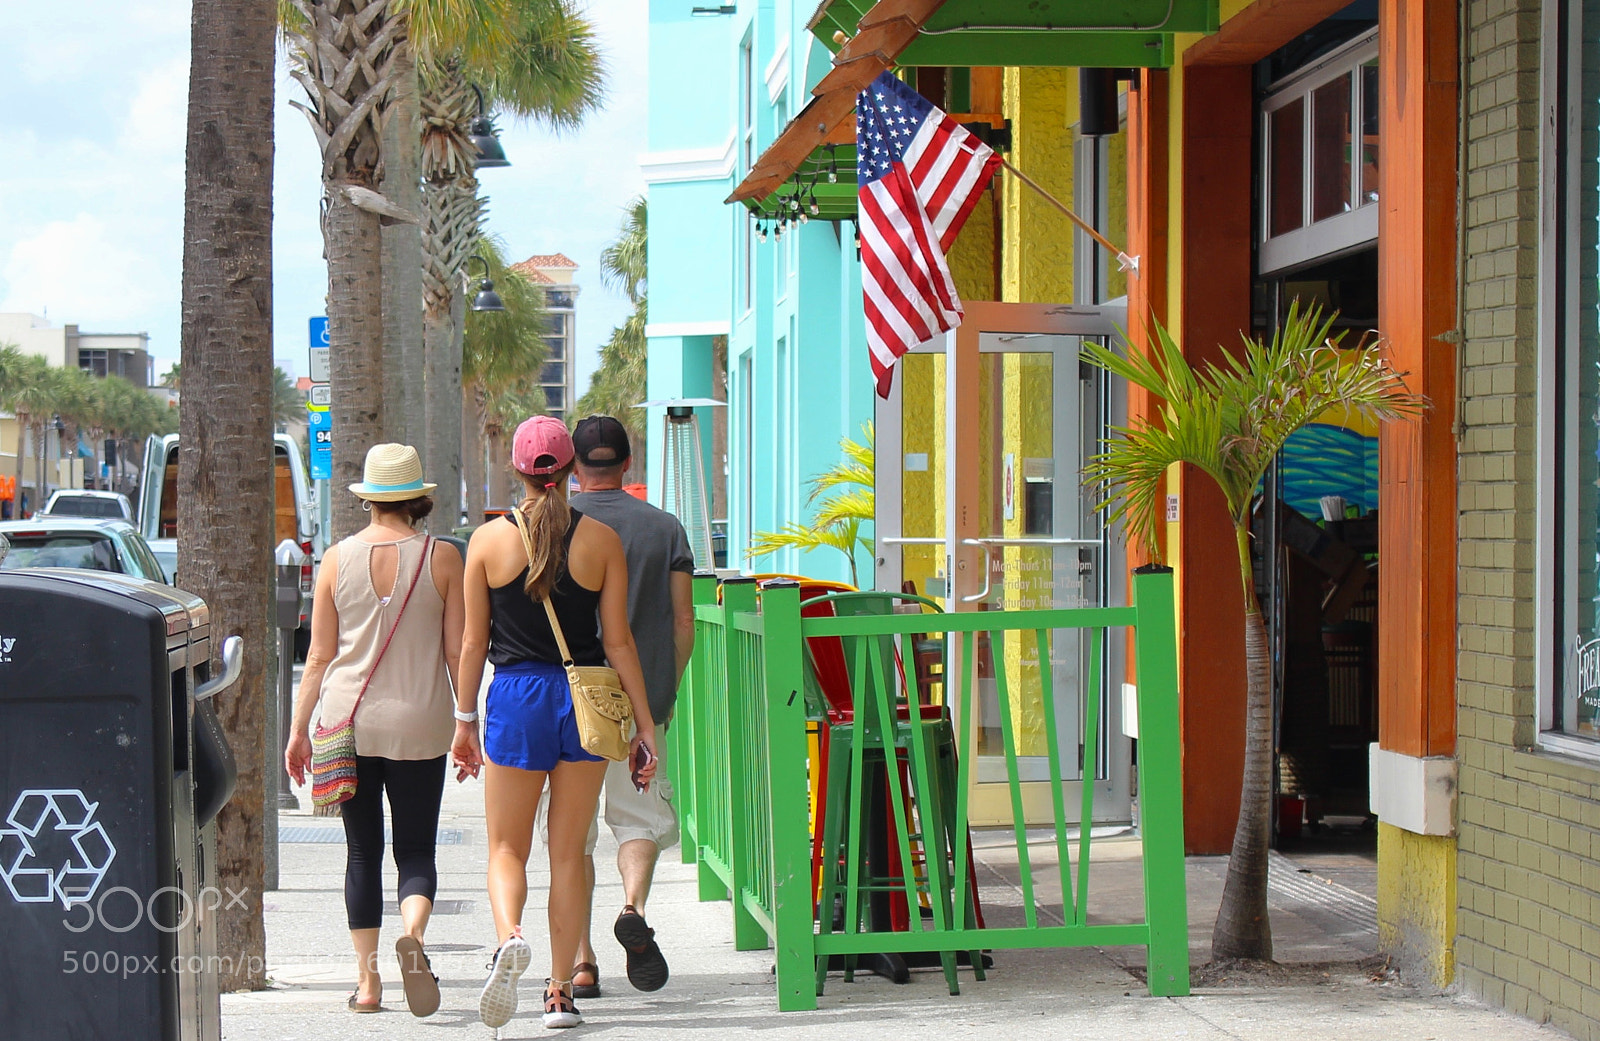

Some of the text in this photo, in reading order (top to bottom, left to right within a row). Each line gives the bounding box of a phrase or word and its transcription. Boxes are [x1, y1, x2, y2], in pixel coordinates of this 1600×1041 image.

[992, 558, 1040, 573] Mon-Thurs
[1002, 577, 1030, 592] Friday
[997, 596, 1036, 610] Saturday
